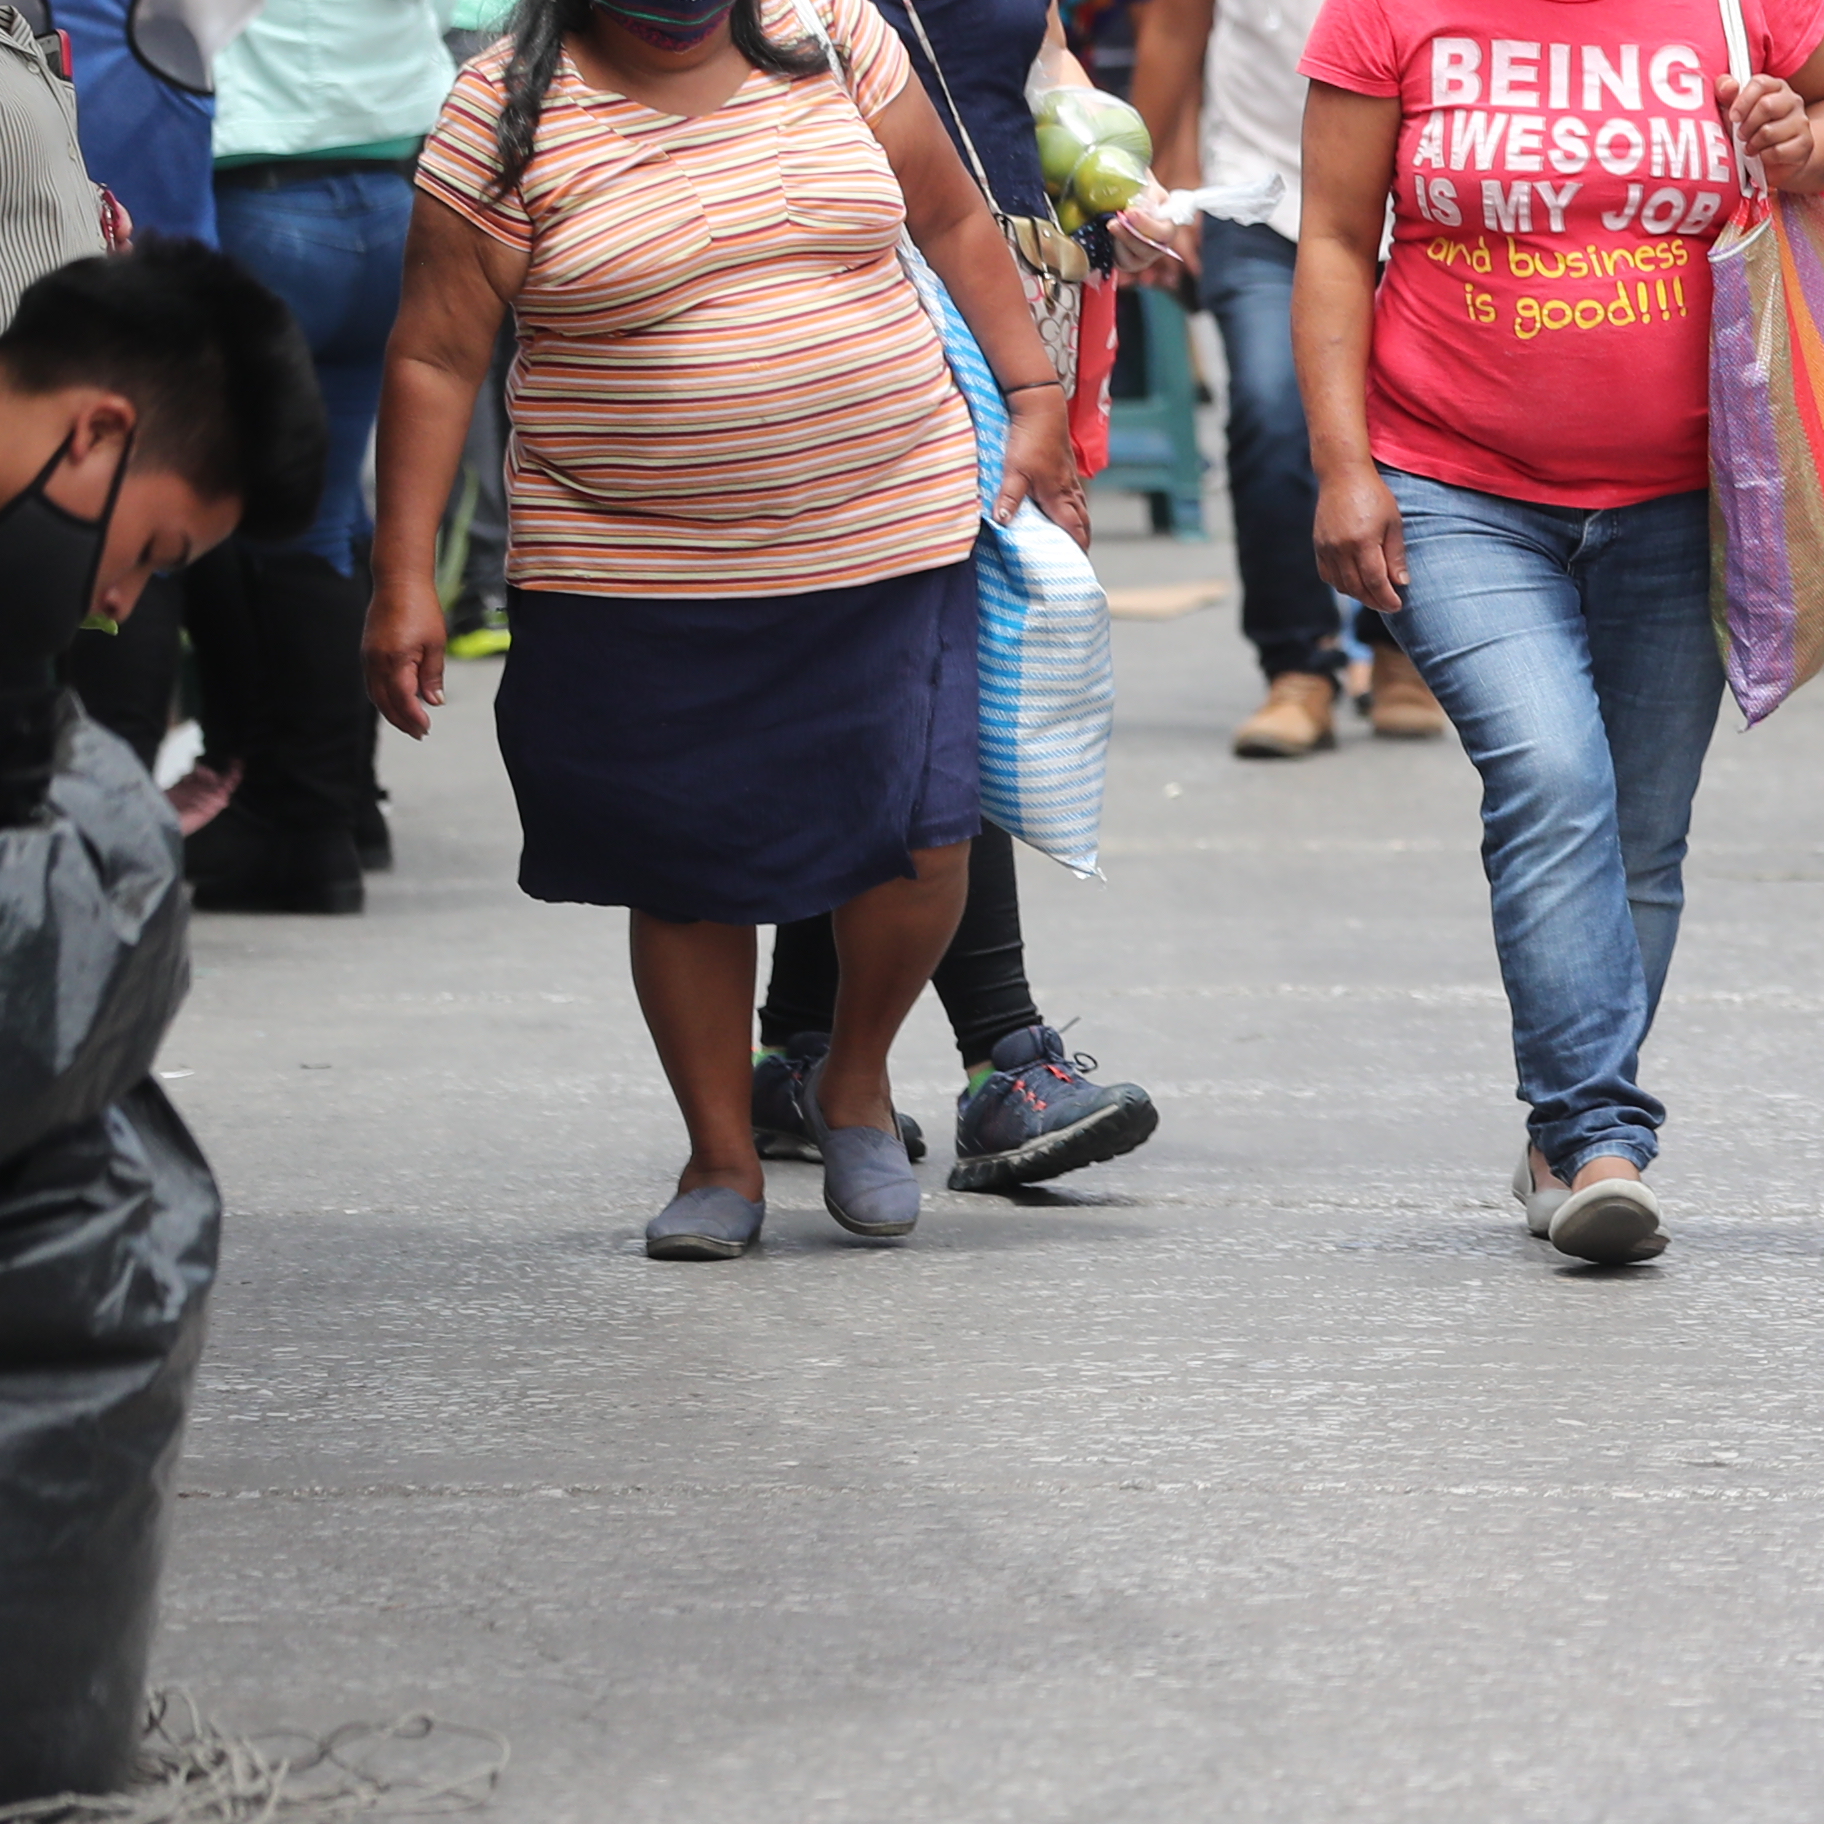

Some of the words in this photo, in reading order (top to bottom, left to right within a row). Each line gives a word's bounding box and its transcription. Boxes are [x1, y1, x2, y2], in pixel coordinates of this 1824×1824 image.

[1430, 36, 1705, 111] BEING
[1412, 109, 1731, 183] AWESOME
[1414, 175, 1463, 228] IS
[1481, 179, 1583, 234] MY
[1602, 182, 1723, 236] JOB
[1426, 236, 1492, 273] and
[1508, 237, 1690, 280] business
[1465, 282, 1497, 324] is
[1513, 277, 1690, 341] good!!!
